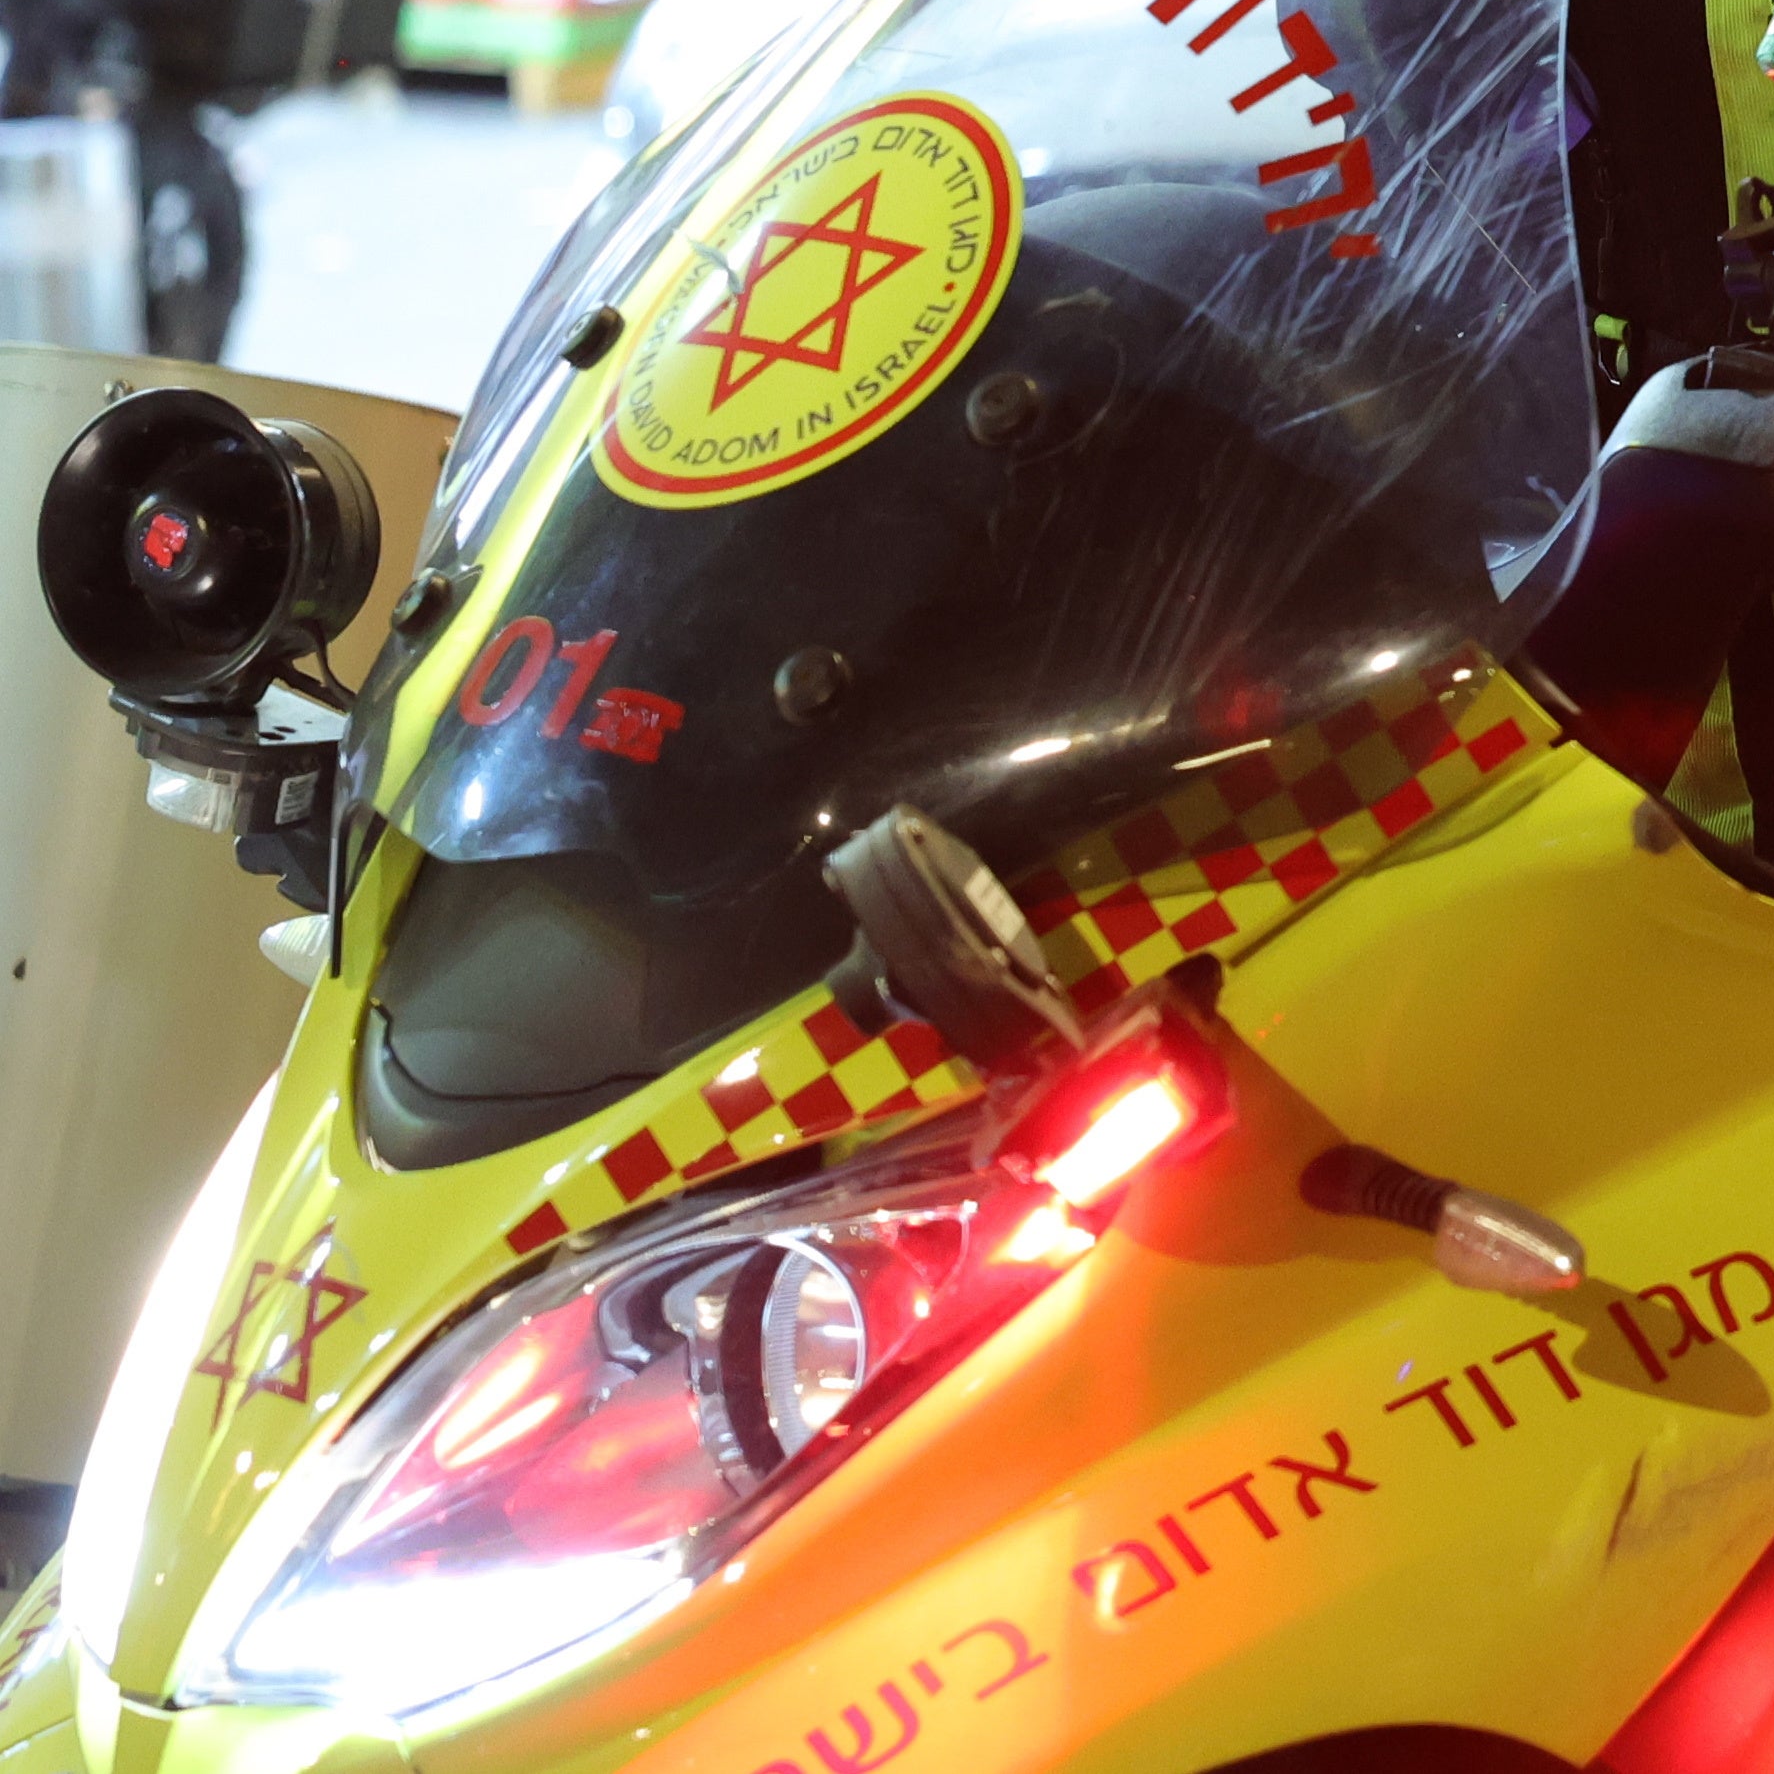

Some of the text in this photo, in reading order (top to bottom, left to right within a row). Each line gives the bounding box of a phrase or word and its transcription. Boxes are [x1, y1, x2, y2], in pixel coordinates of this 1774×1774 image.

[871, 124, 953, 167] אדום
[943, 156, 981, 208] דוד
[629, 381, 674, 452] DAVID
[672, 426, 780, 466] ADOM
[797, 402, 835, 441] IN
[845, 297, 956, 411] ISRAEL
[1383, 1328, 1582, 1450] דוד
[1070, 1428, 1380, 1619] אדום
[748, 1618, 1050, 1774] ביש
